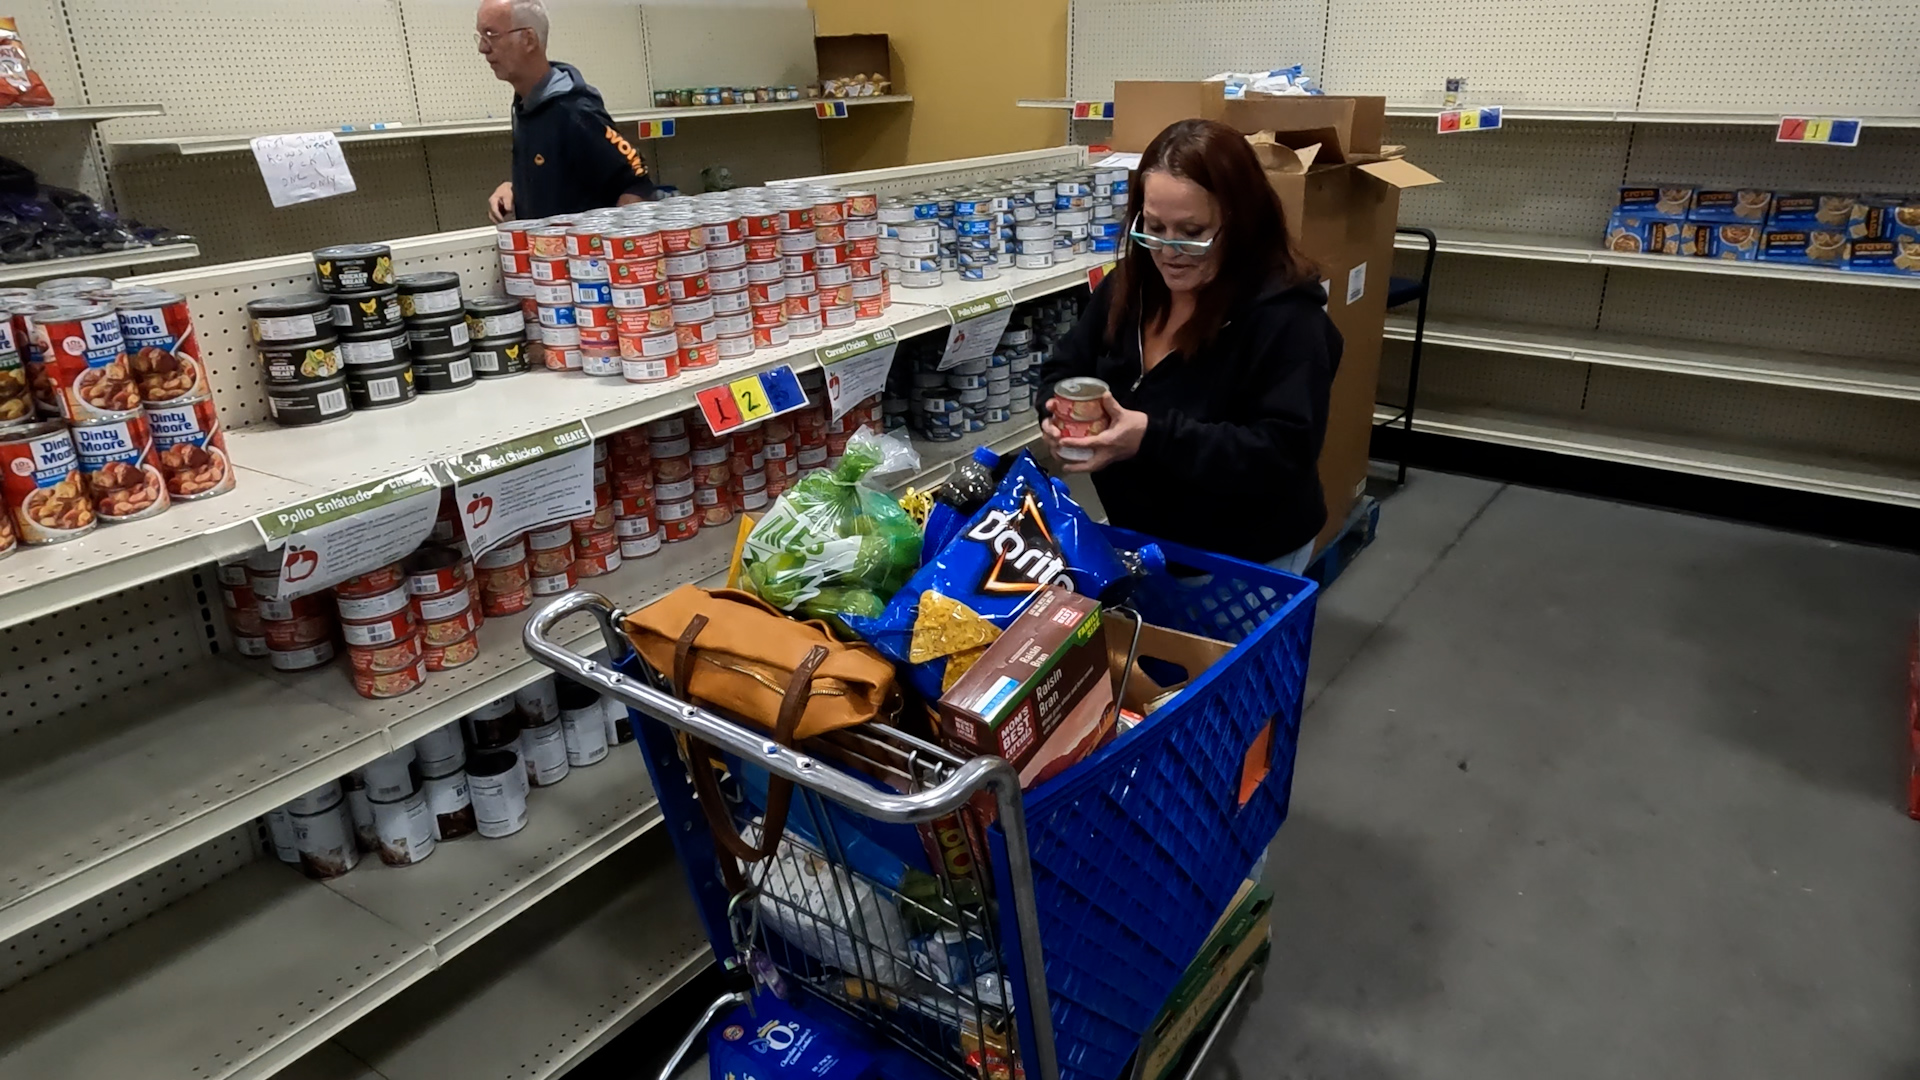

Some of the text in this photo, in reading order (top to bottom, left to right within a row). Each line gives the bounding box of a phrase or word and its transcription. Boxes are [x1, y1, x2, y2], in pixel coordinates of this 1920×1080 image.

[1464, 115, 1472, 126] 2
[1811, 123, 1820, 138] 1
[288, 157, 317, 169] PCK
[309, 174, 336, 192] ONLY
[119, 314, 155, 327] Dinty
[93, 330, 120, 346] Moo
[121, 324, 162, 337] Moore
[140, 336, 174, 347] STEW
[846, 339, 868, 352] Chicken
[714, 397, 731, 424] 1
[741, 390, 761, 412] 2
[150, 411, 187, 426] Dinty
[150, 421, 193, 434] Moore
[78, 429, 119, 446] Dinty
[173, 431, 205, 443] STEW
[553, 428, 587, 446] CREATE
[79, 439, 126, 452] Moore
[105, 450, 138, 462] STEW
[505, 445, 544, 463] Chicken
[36, 465, 67, 480] BEEF
[278, 507, 315, 527] Pollo
[967, 509, 1074, 592] Dorit
[1077, 609, 1099, 639] FAMILY
[1087, 617, 1101, 638] SIZE
[1019, 645, 1042, 664] Raisin
[1030, 653, 1049, 667] Bran
[1035, 668, 1063, 701] Raisin
[1039, 690, 1060, 718] Bran
[1001, 705, 1029, 740] MOM'S
[1002, 714, 1030, 751] BEST
